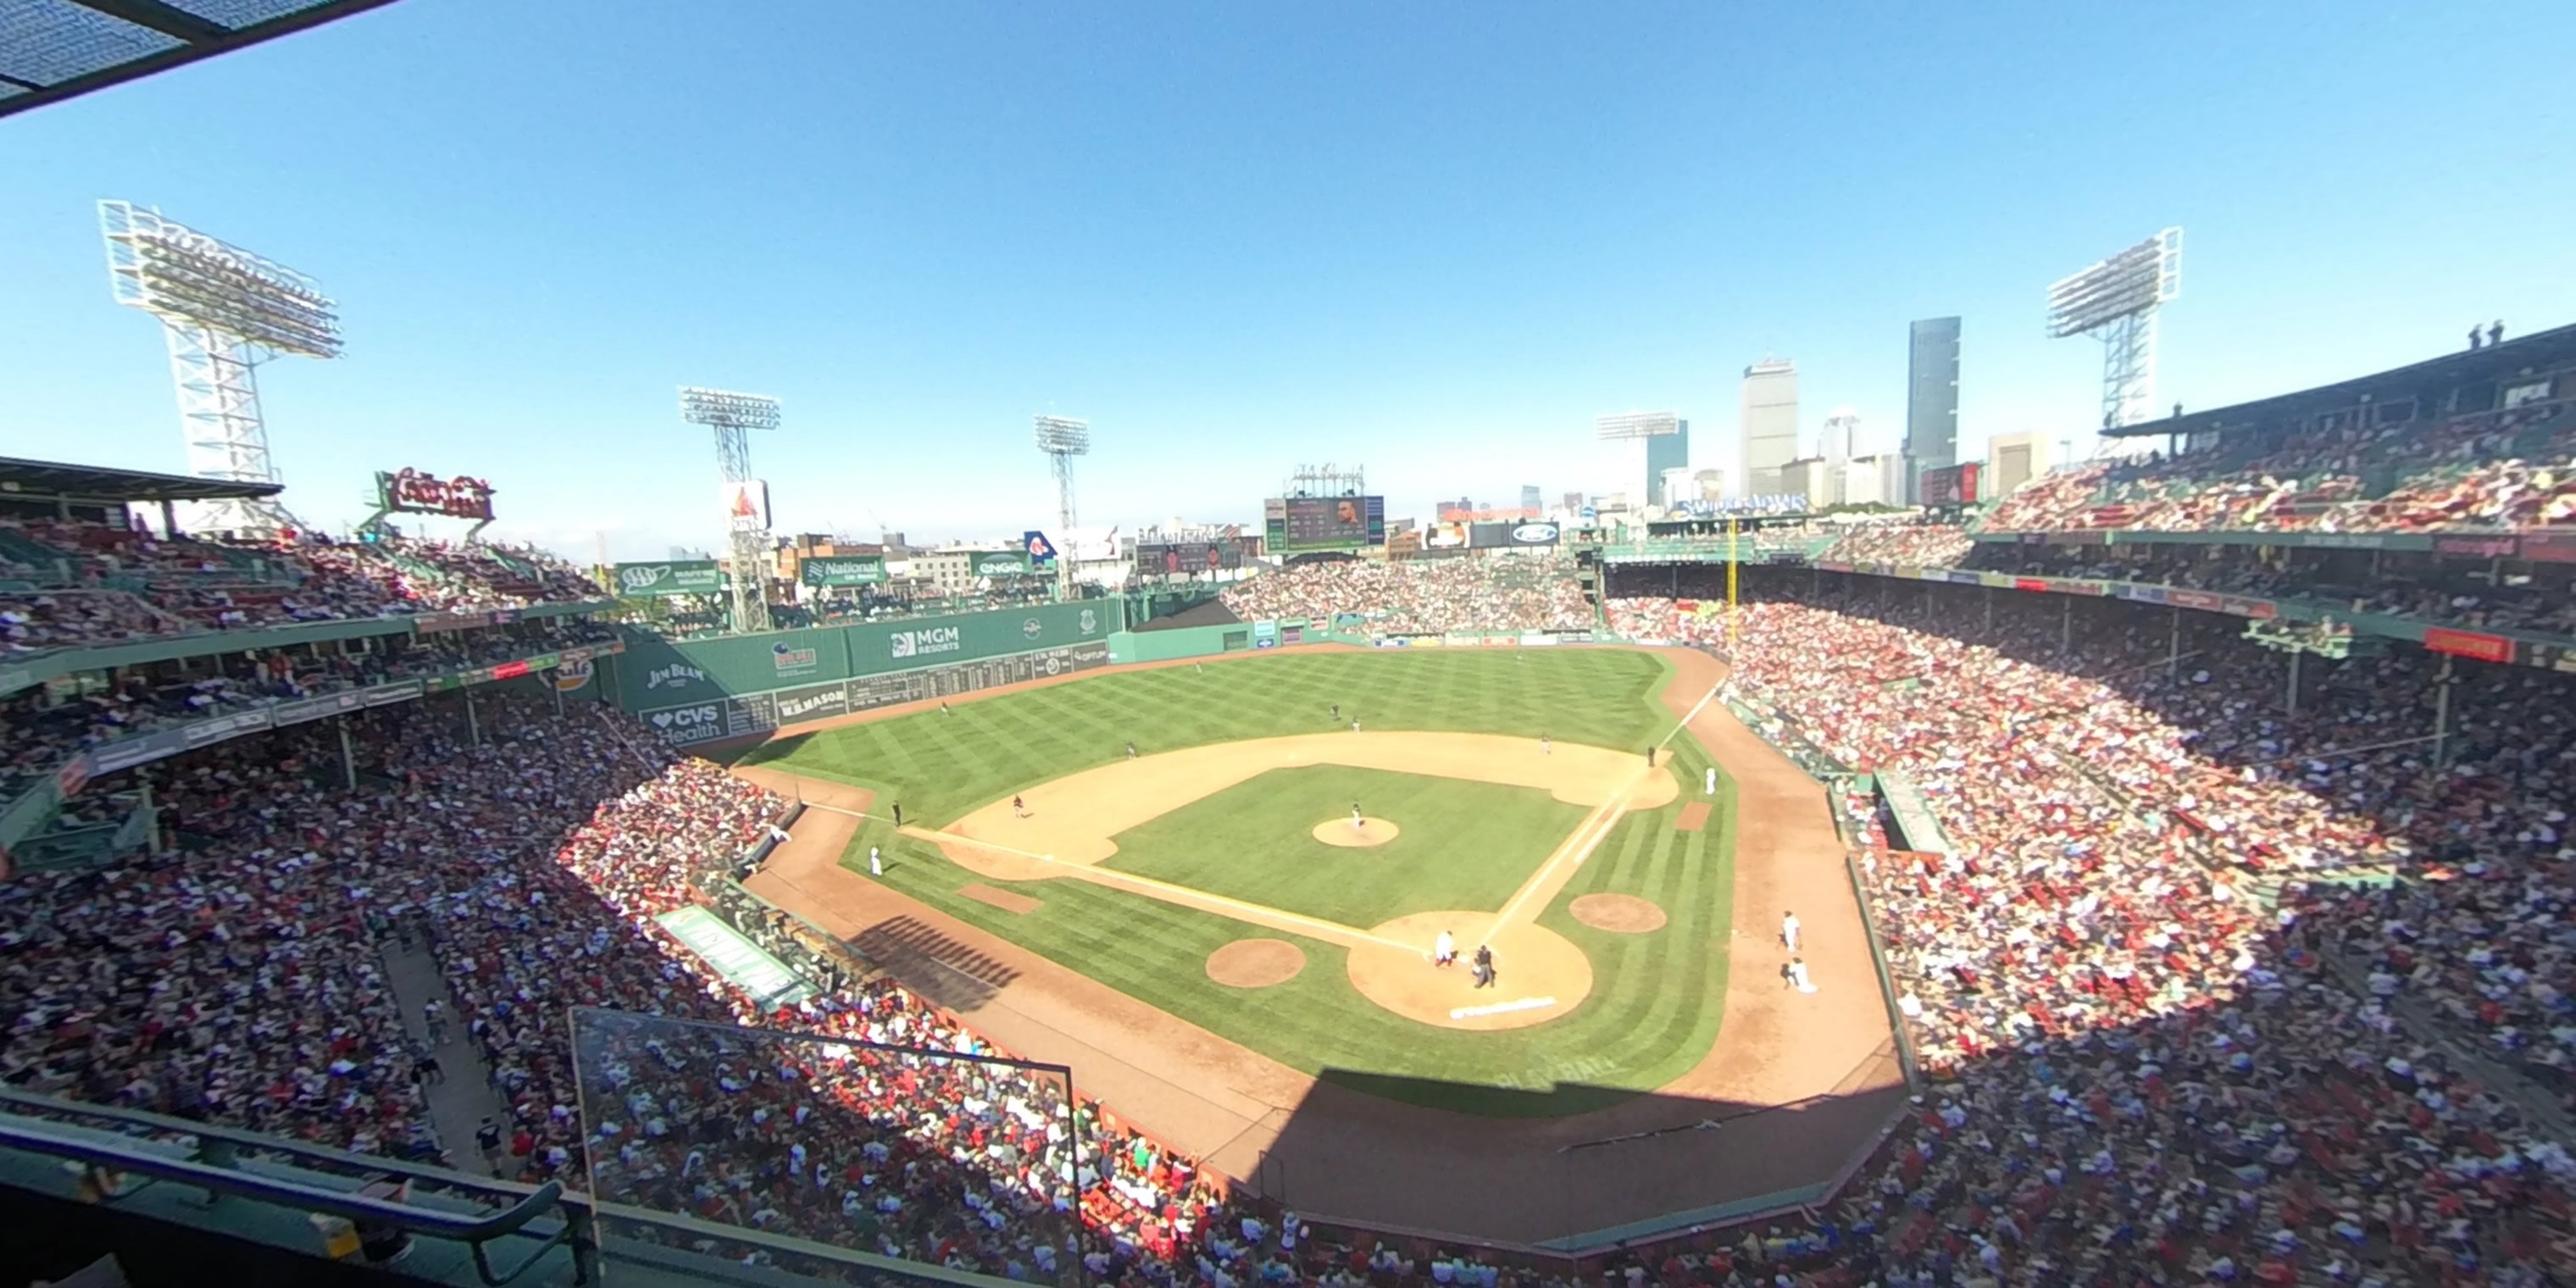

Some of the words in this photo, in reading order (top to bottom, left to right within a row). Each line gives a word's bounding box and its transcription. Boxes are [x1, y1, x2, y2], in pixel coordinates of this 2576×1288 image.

[824, 561, 879, 575] National
[916, 626, 959, 645] MGM
[918, 641, 960, 654] RESORTS
[647, 668, 670, 690] JIM
[670, 663, 705, 681] BEAM
[675, 705, 719, 726] CVS
[660, 722, 722, 744] Health
